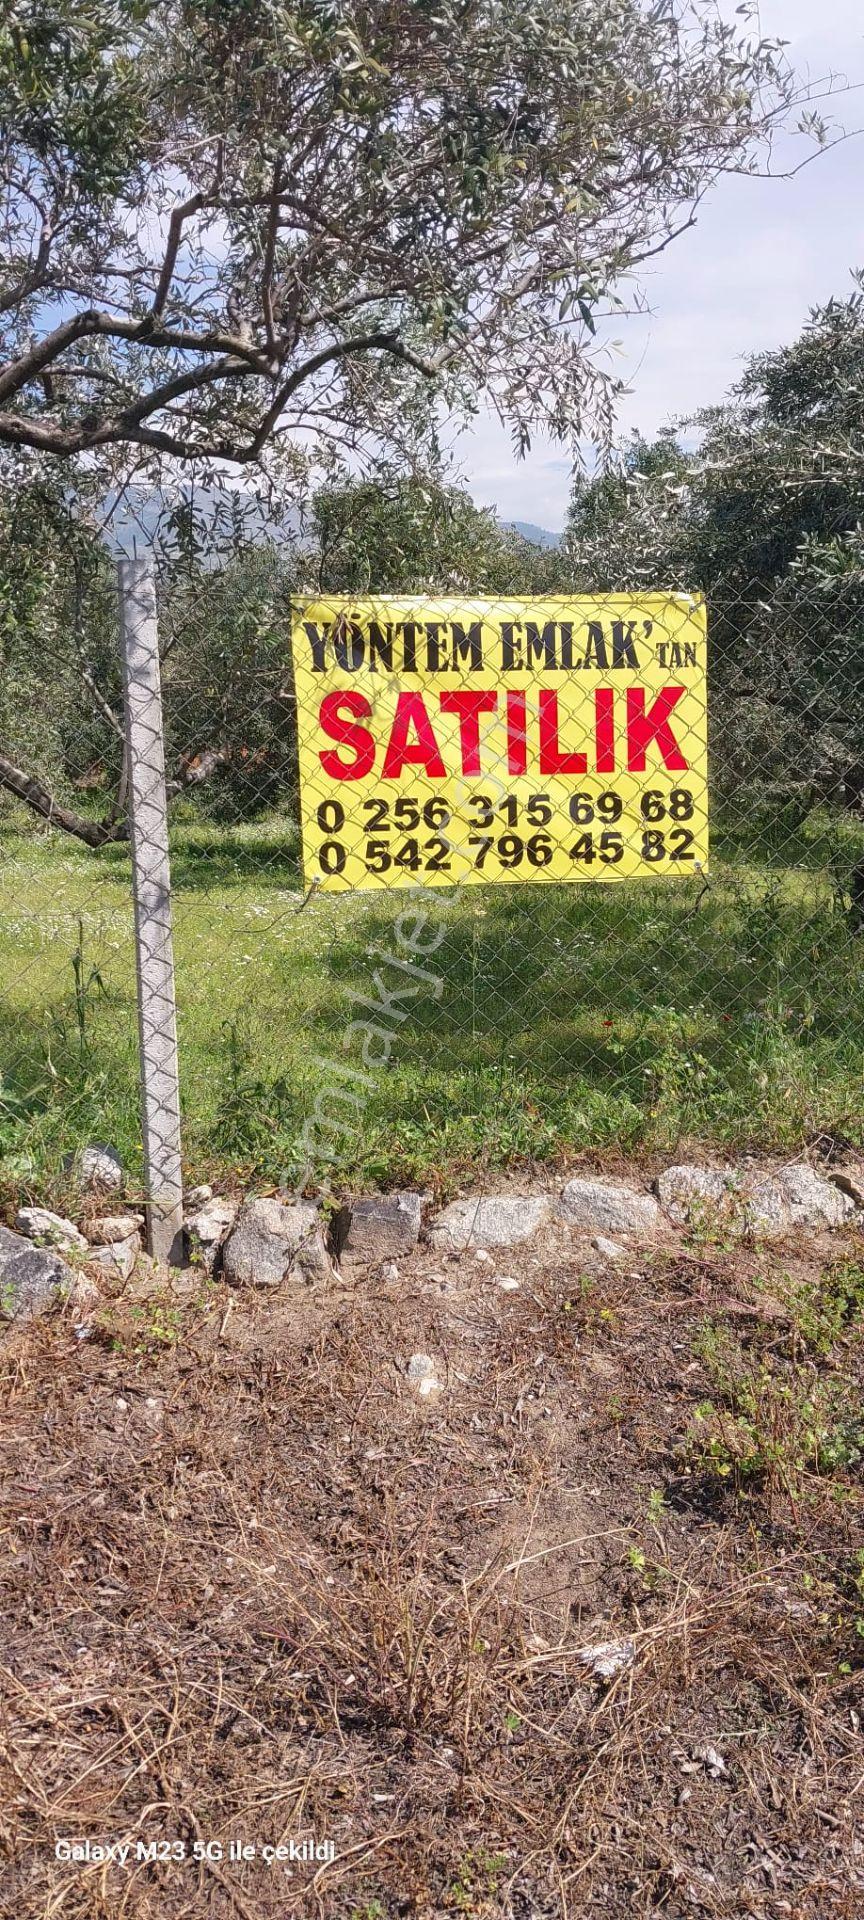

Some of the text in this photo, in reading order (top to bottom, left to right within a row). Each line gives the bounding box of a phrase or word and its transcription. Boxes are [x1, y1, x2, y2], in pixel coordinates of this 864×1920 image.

[303, 613, 484, 673] YÖNTEM
[318, 686, 689, 781] SATILIK
[317, 788, 695, 833] 0 256 315 69 68
[318, 827, 695, 875] 0 542 796 45 82
